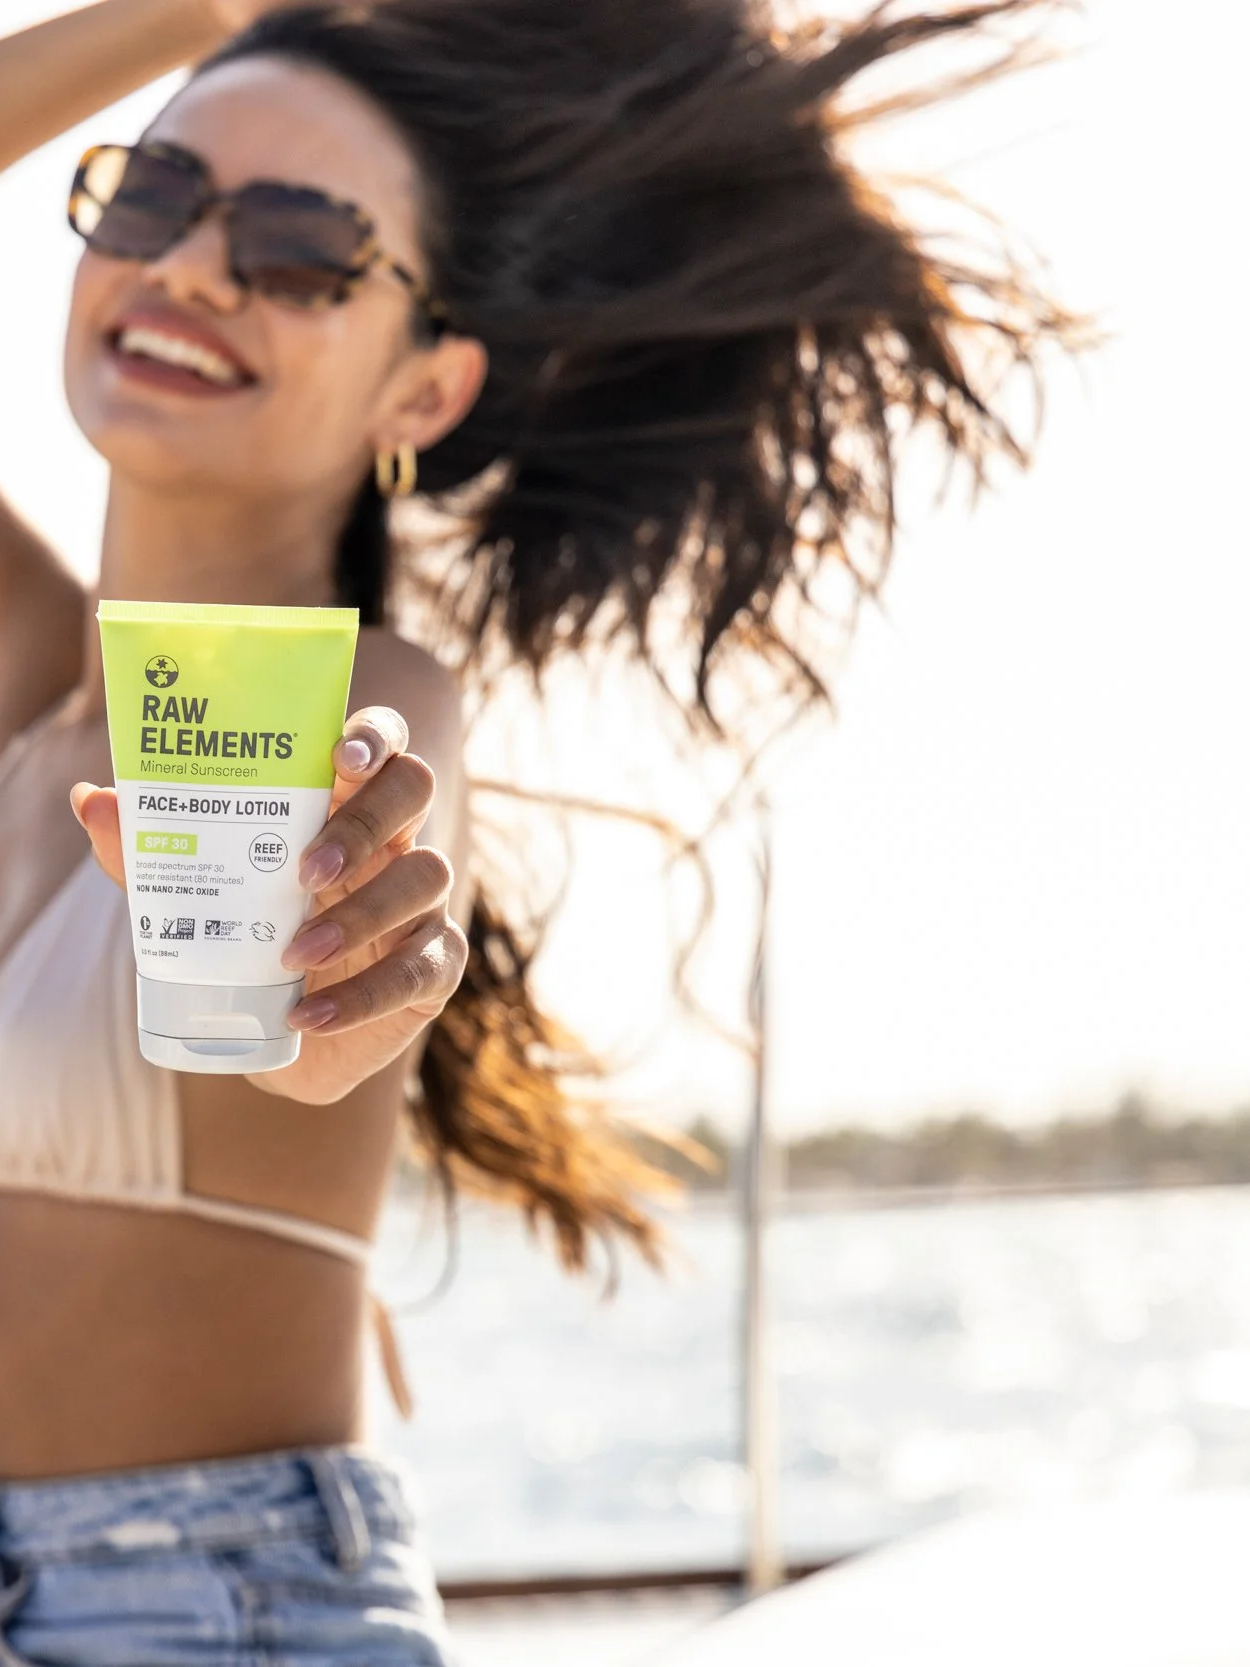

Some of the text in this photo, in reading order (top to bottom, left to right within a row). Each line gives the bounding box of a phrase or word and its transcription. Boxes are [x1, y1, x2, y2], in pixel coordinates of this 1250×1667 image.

[142, 694, 209, 725] RAW
[140, 760, 258, 778] Mineral Sunscreen
[138, 795, 290, 817] FACE+BODY LOTION
[144, 836, 188, 850] SPF 30
[254, 843, 283, 854] REEF
[253, 856, 282, 864] FRIENDLY
[135, 861, 224, 873] broad spectrum SPF 30
[136, 873, 244, 885] water resistant (80 minutes)
[136, 885, 220, 896] NON NANO ZINC OXIDE
